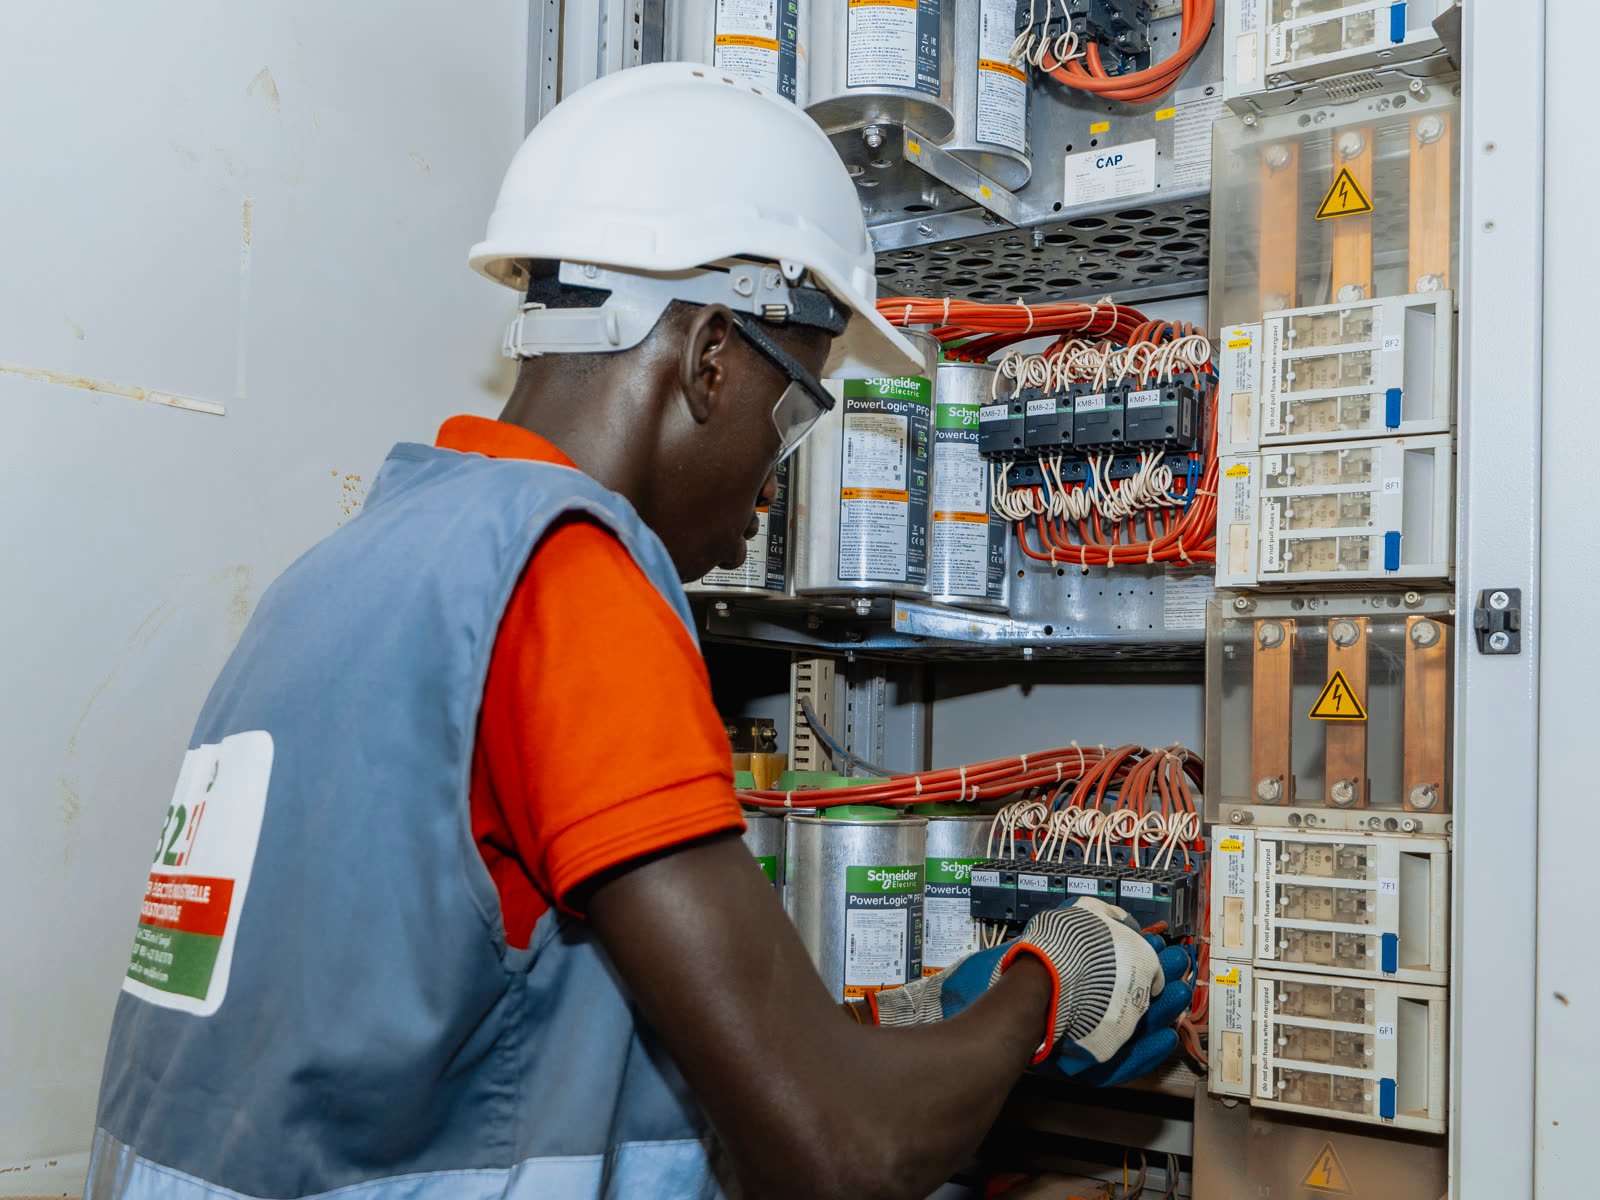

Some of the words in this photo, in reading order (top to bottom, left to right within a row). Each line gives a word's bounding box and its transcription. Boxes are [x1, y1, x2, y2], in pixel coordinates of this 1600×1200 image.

[1096, 154, 1123, 169] CAP
[1384, 338, 1400, 348] 8F2
[890, 387, 919, 397] Electric
[1077, 398, 1104, 408] KM8-1.1
[1129, 394, 1158, 403] KM8-1.2
[916, 405, 930, 417] PFC
[1028, 402, 1055, 412] KM8-2.2
[981, 409, 1006, 418] KM8-2.1
[1269, 419, 1275, 427] do
[1385, 482, 1399, 490] 8F1
[1268, 556, 1273, 564] do
[867, 869, 918, 881] Schneider
[972, 875, 998, 883] KM6-1.1
[1019, 878, 1046, 887] KM6-1.2
[1069, 882, 1096, 891] KM7-1.1
[1381, 882, 1395, 890] 7F1
[925, 884, 971, 896] PowerLog
[1122, 885, 1151, 894] KM7-1.2
[1264, 944, 1269, 952] do
[1262, 1083, 1268, 1091] do
